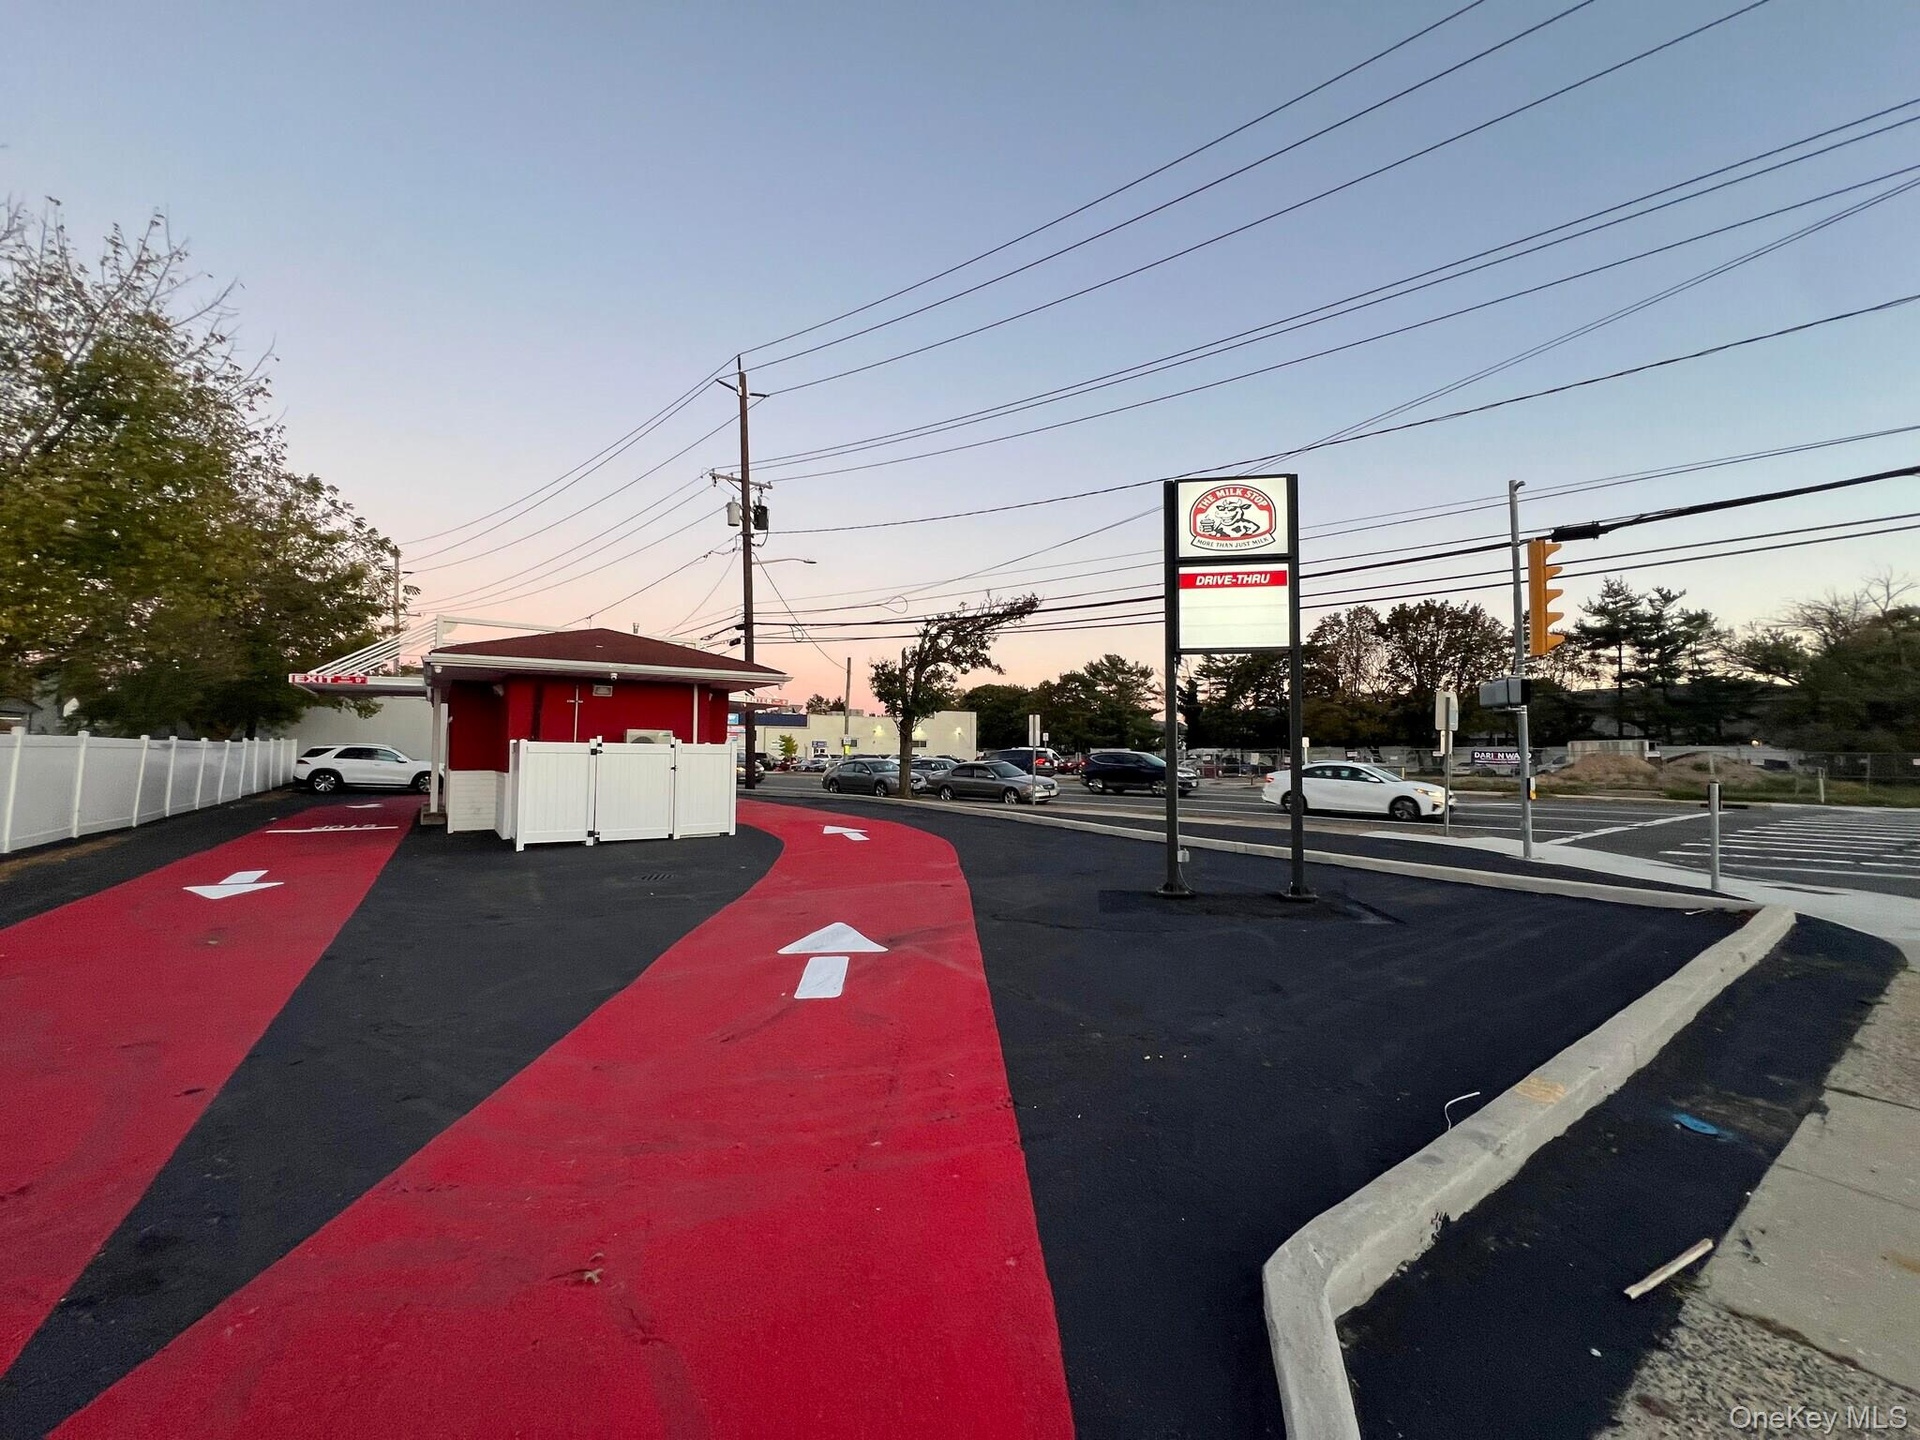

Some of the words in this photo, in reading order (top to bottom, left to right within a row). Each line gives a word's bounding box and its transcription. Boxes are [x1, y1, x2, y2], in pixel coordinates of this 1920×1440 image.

[1197, 495, 1216, 510] THE
[1215, 488, 1243, 499] MILK
[1244, 489, 1268, 507] STOP
[1197, 539, 1214, 547] MORE
[1252, 537, 1269, 546] MILK
[1195, 573, 1270, 586] DRIVE-THRU
[294, 674, 335, 684] EXIT
[1505, 752, 1532, 760] WAD
